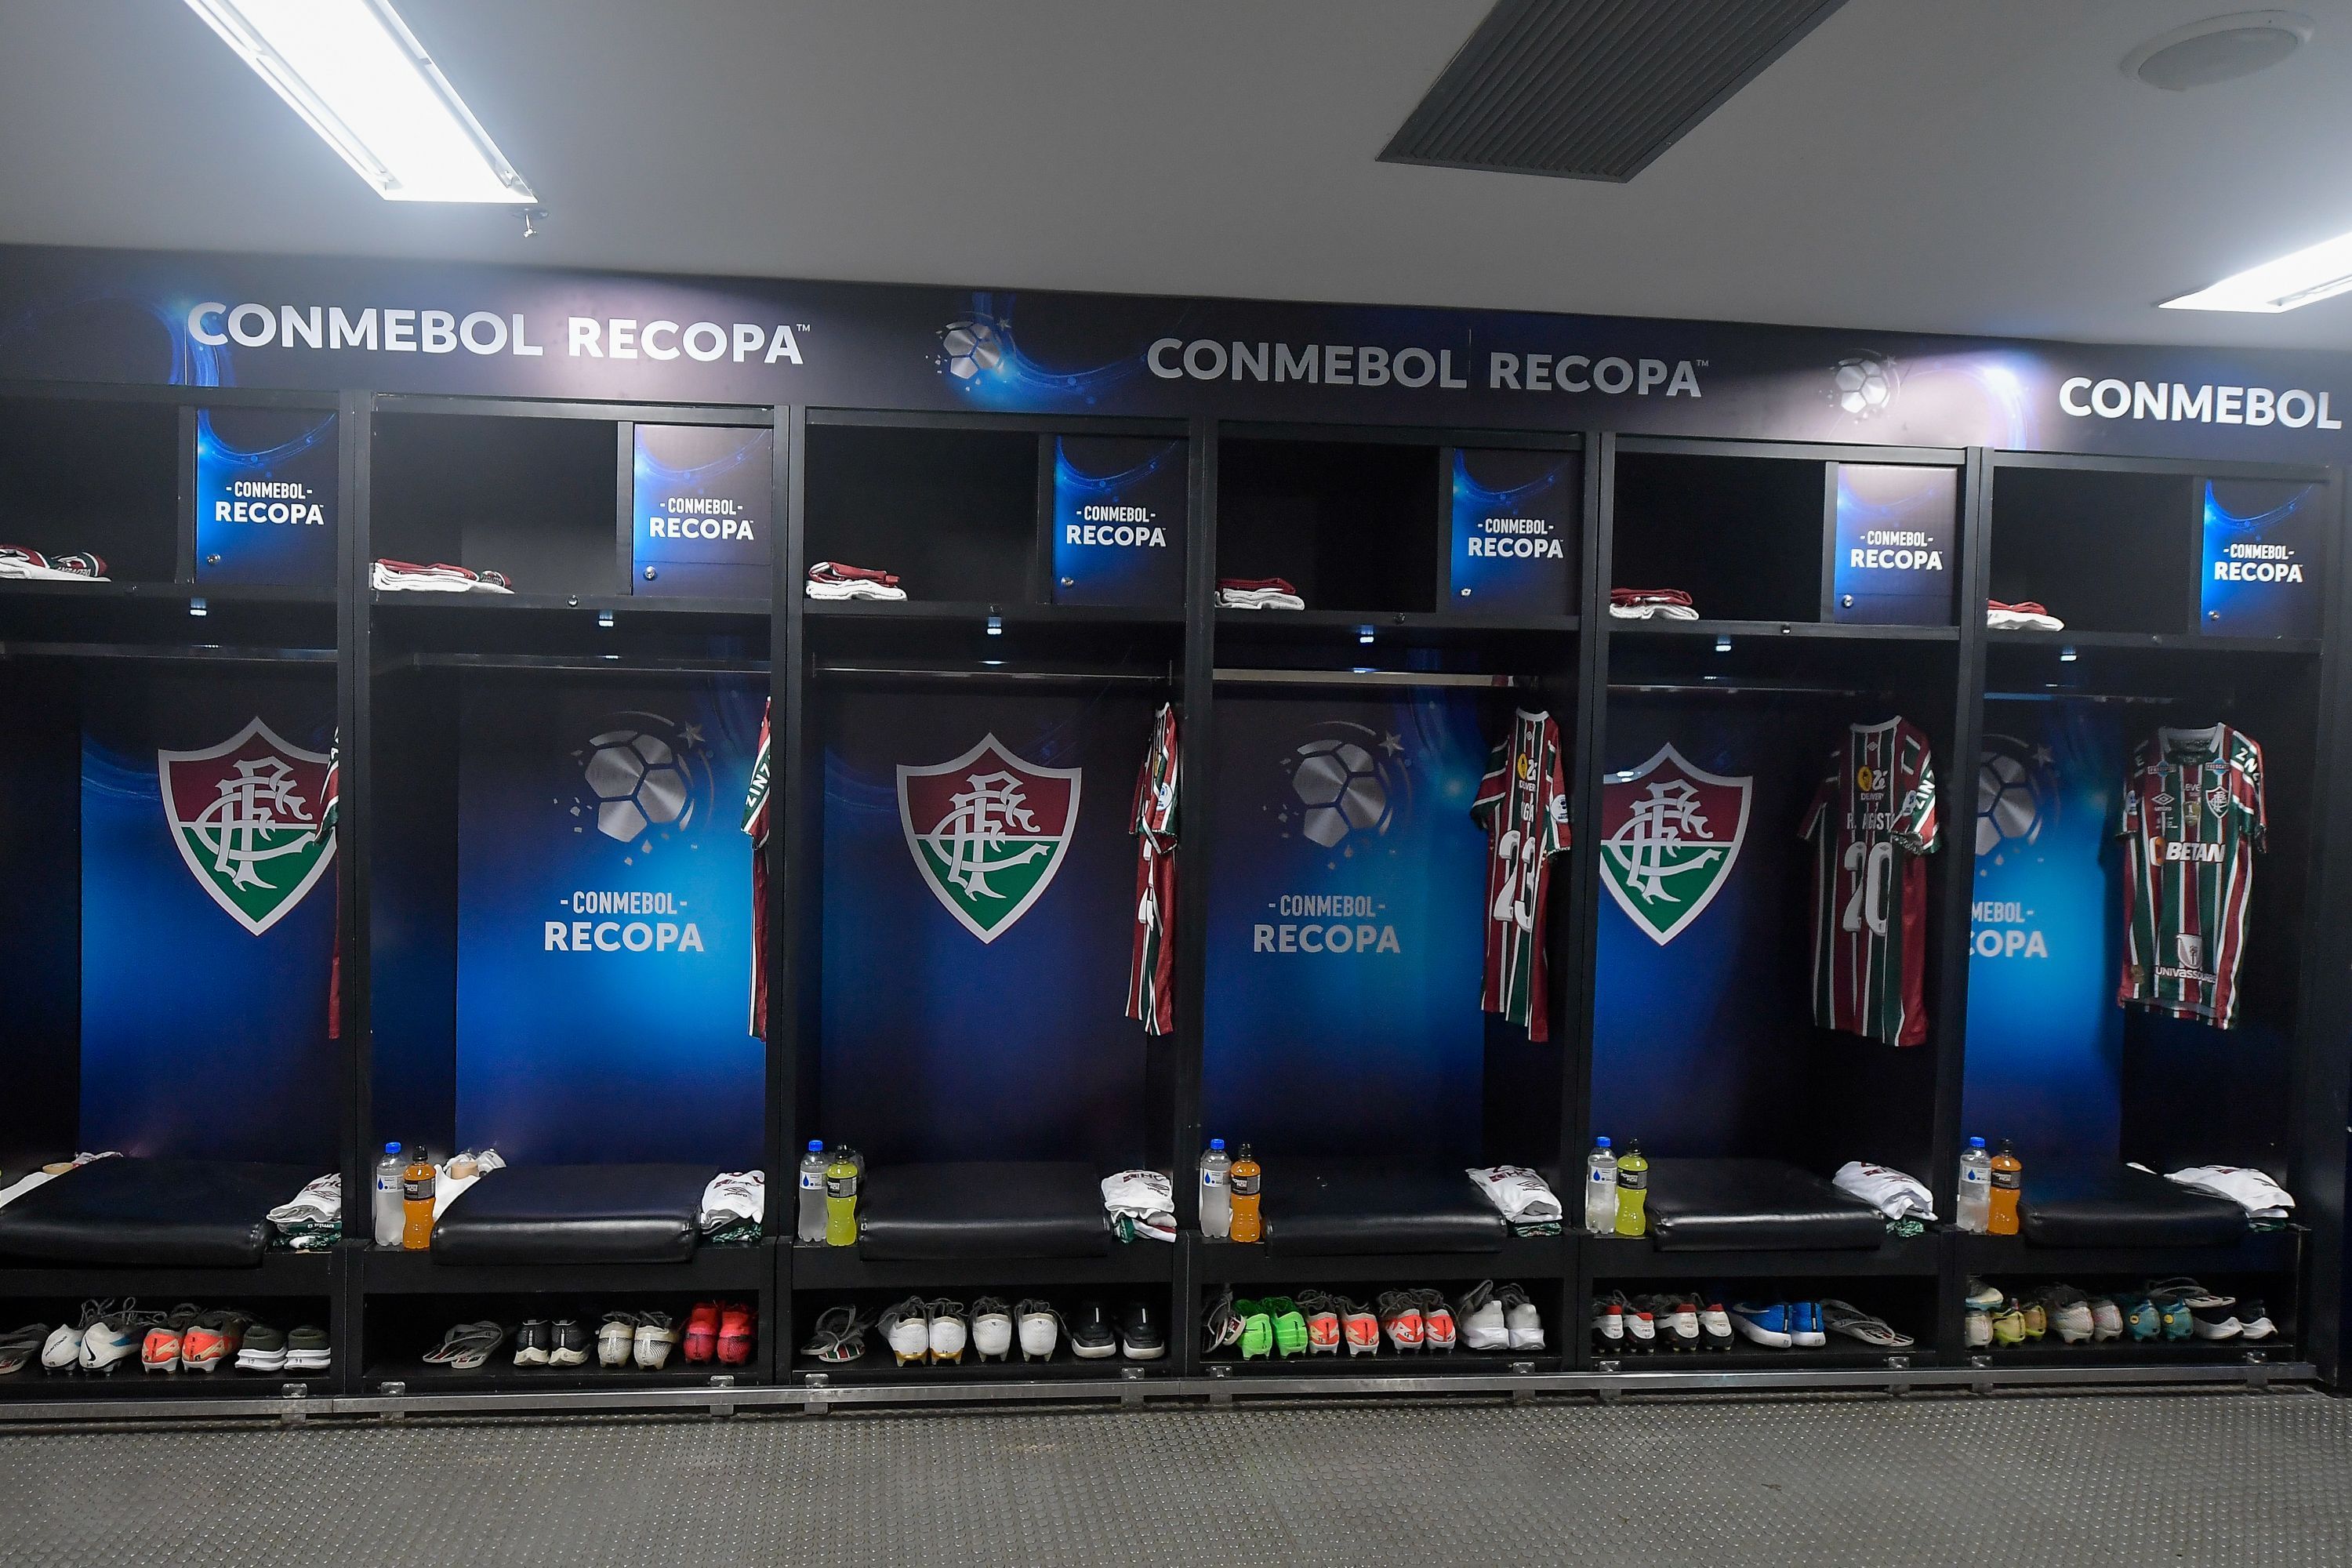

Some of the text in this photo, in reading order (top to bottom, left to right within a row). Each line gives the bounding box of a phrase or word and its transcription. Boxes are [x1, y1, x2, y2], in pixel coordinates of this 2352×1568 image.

[188, 303, 544, 356] CONMEBOL
[568, 317, 804, 365] RECOPA
[1147, 338, 1468, 389] CONMEBOL
[1490, 352, 1702, 397] RECOPA
[2059, 377, 2342, 430] CONMEBOL
[216, 502, 325, 525] RECOPA
[649, 517, 754, 540] RECOPA
[1066, 524, 1166, 547] RECOPA
[1468, 537, 1563, 558] RECOPA
[1851, 549, 1943, 571] RECOPA
[2215, 561, 2303, 583] RECOPA
[1486, 830, 1536, 932] 23
[1842, 841, 1893, 937] 20
[544, 921, 704, 952] RECOPA
[1254, 924, 1401, 953] RECOPA
